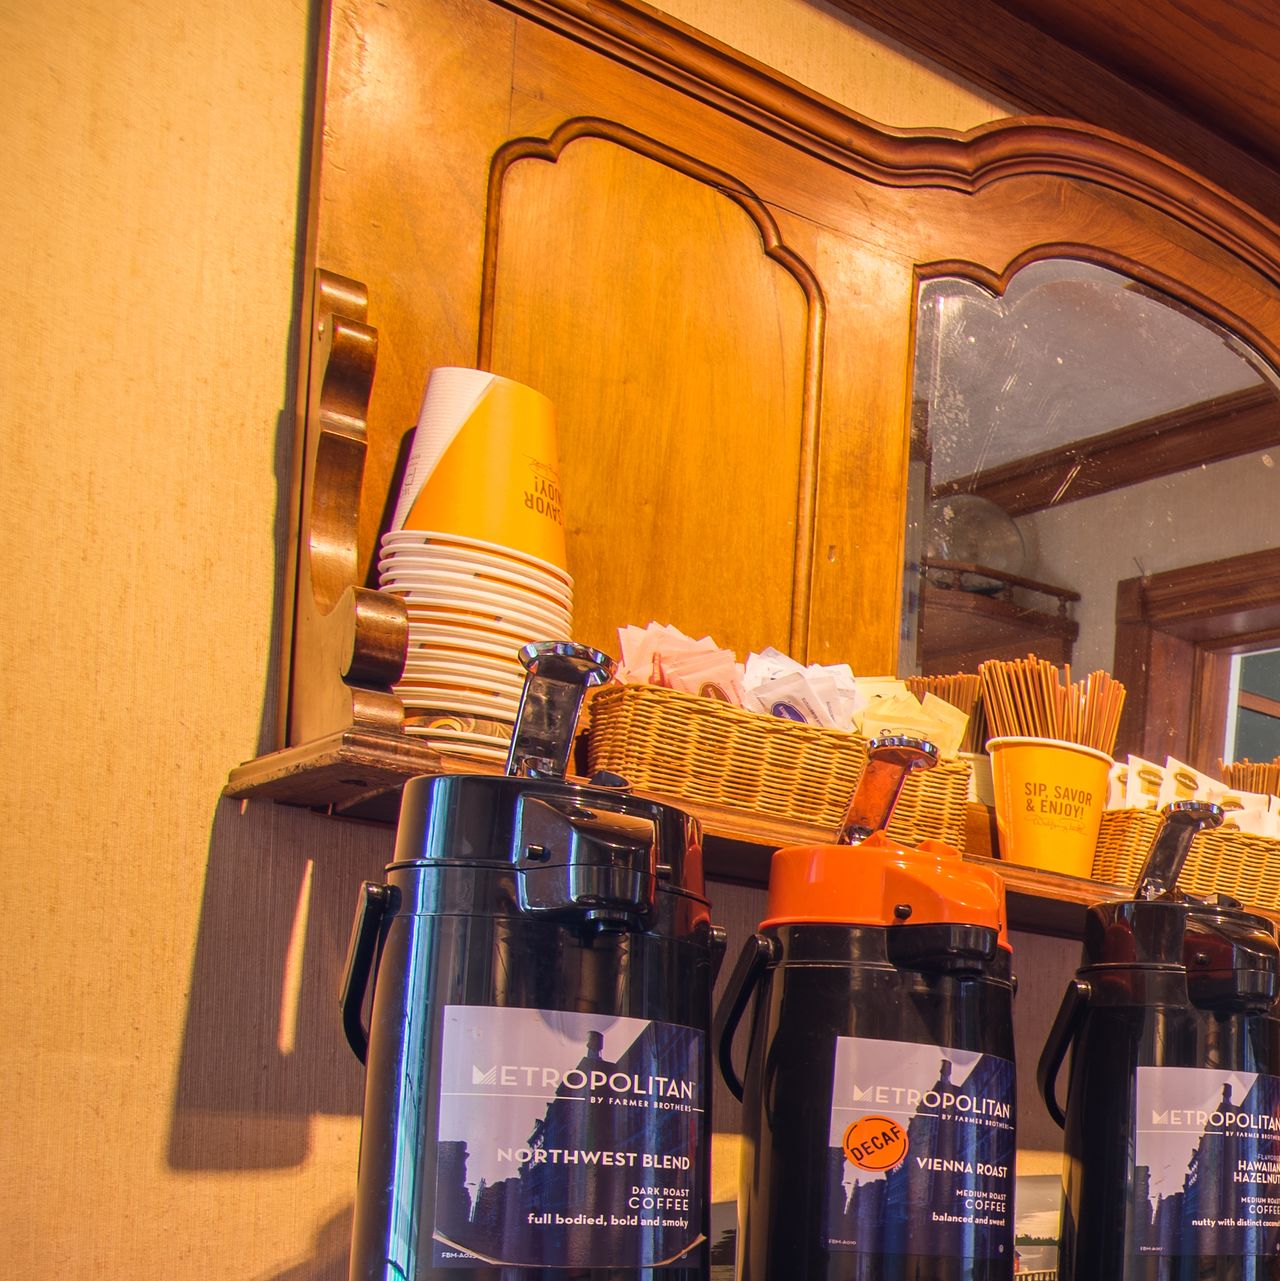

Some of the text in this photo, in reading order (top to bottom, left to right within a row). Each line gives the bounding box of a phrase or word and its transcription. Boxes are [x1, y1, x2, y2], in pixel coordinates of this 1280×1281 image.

[1053, 786, 1093, 807] SAVOR
[1025, 799, 1085, 820] & ENJOY!
[472, 1064, 693, 1100] METROPOLITAN
[590, 1096, 692, 1113] BY FARMER BROTHERS
[853, 1085, 1010, 1120] METROPOLITAN
[941, 1113, 952, 1121] BY
[955, 1115, 983, 1125] FARMER
[850, 1124, 902, 1162] DECAF
[497, 1147, 690, 1170] NORTHWEST BLEND
[1238, 1159, 1280, 1173] HAWAIIAN
[916, 1157, 1008, 1179] VIENNA ROAST
[1233, 1172, 1280, 1185] HAZELNUT
[632, 1185, 690, 1198] DARK ROAST
[956, 1189, 1007, 1201] MEDIUM ROAST
[628, 1196, 689, 1211] COFFEE
[965, 1199, 1007, 1213] COFFEE
[1241, 1196, 1266, 1204] MEDIUM
[1249, 1204, 1280, 1215] COFFEE
[528, 1212, 689, 1229] full bodied, bold and smoky
[932, 1211, 1006, 1227] balanced and sweet
[1192, 1218, 1216, 1229] nutty
[1218, 1217, 1235, 1227] with
[1237, 1218, 1262, 1227] distinct
